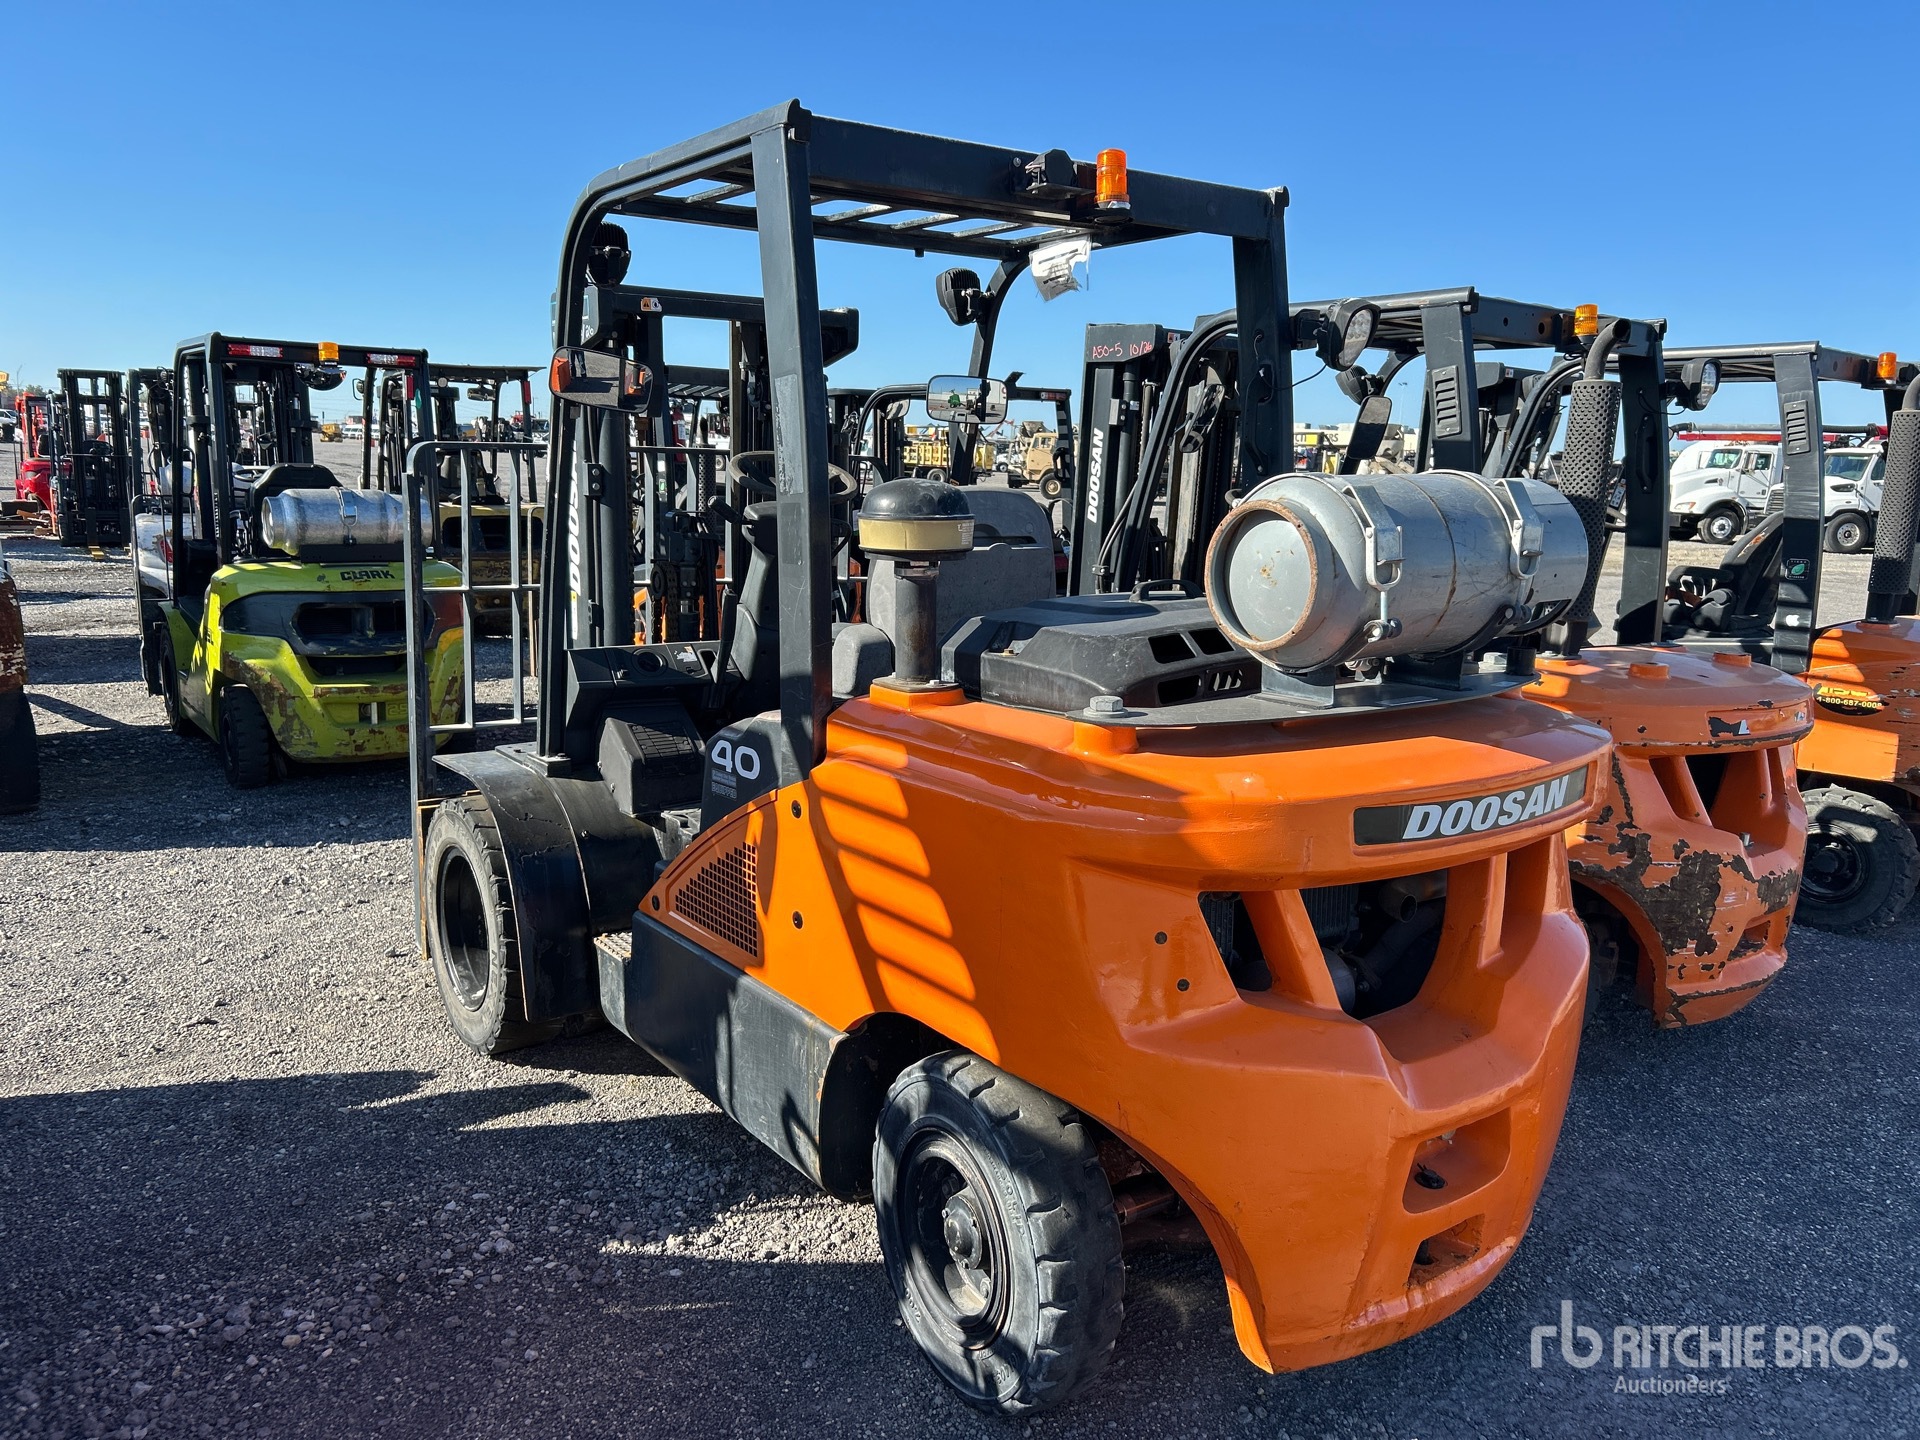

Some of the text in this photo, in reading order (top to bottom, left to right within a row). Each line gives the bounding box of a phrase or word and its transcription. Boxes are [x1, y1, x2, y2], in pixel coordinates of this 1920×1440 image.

[1087, 428, 1104, 523] DOOSAN
[340, 570, 395, 580] CLARK
[711, 740, 760, 780] 40
[1402, 774, 1570, 840] DOOSAN
